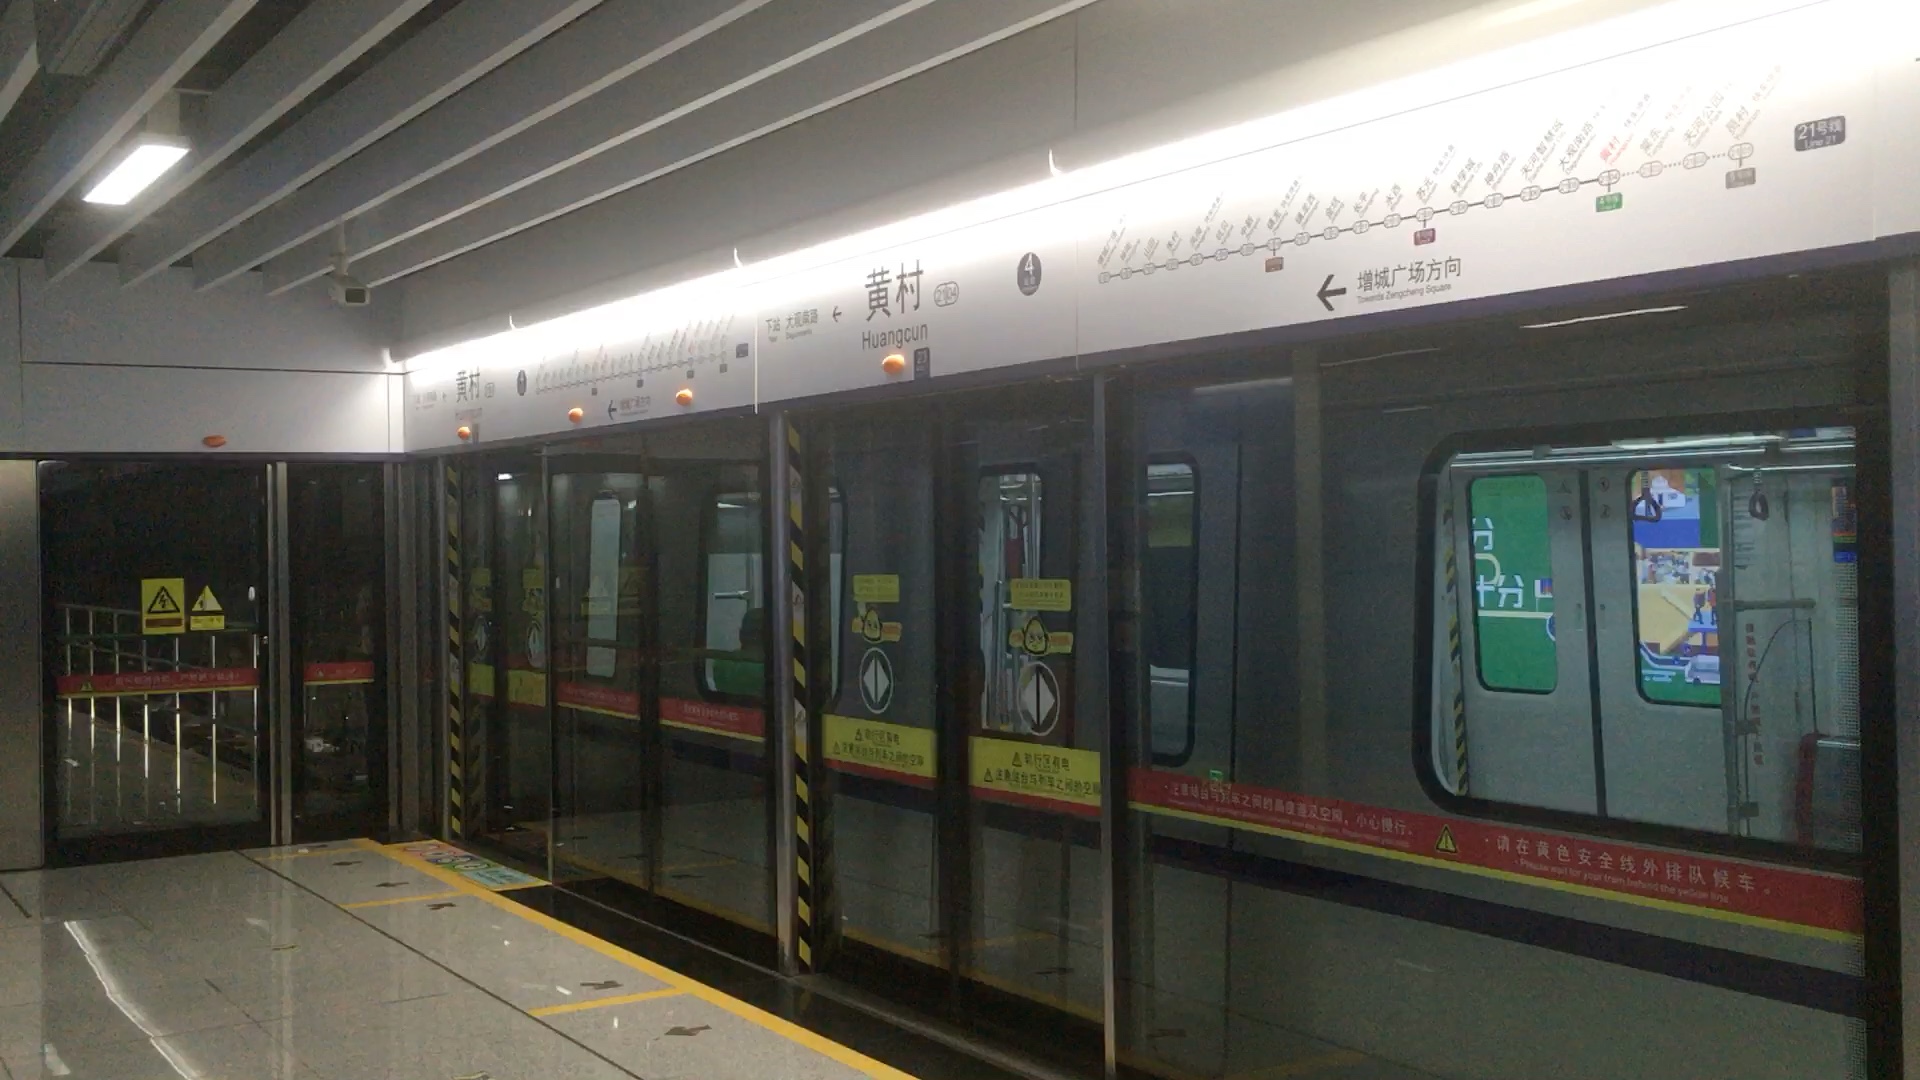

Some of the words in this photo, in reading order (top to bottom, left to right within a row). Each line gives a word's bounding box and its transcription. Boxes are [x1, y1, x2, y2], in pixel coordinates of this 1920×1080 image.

[865, 258, 924, 321] 黄村
[1357, 255, 1461, 292] 增城广场方向
[861, 323, 928, 353] Huangcun
